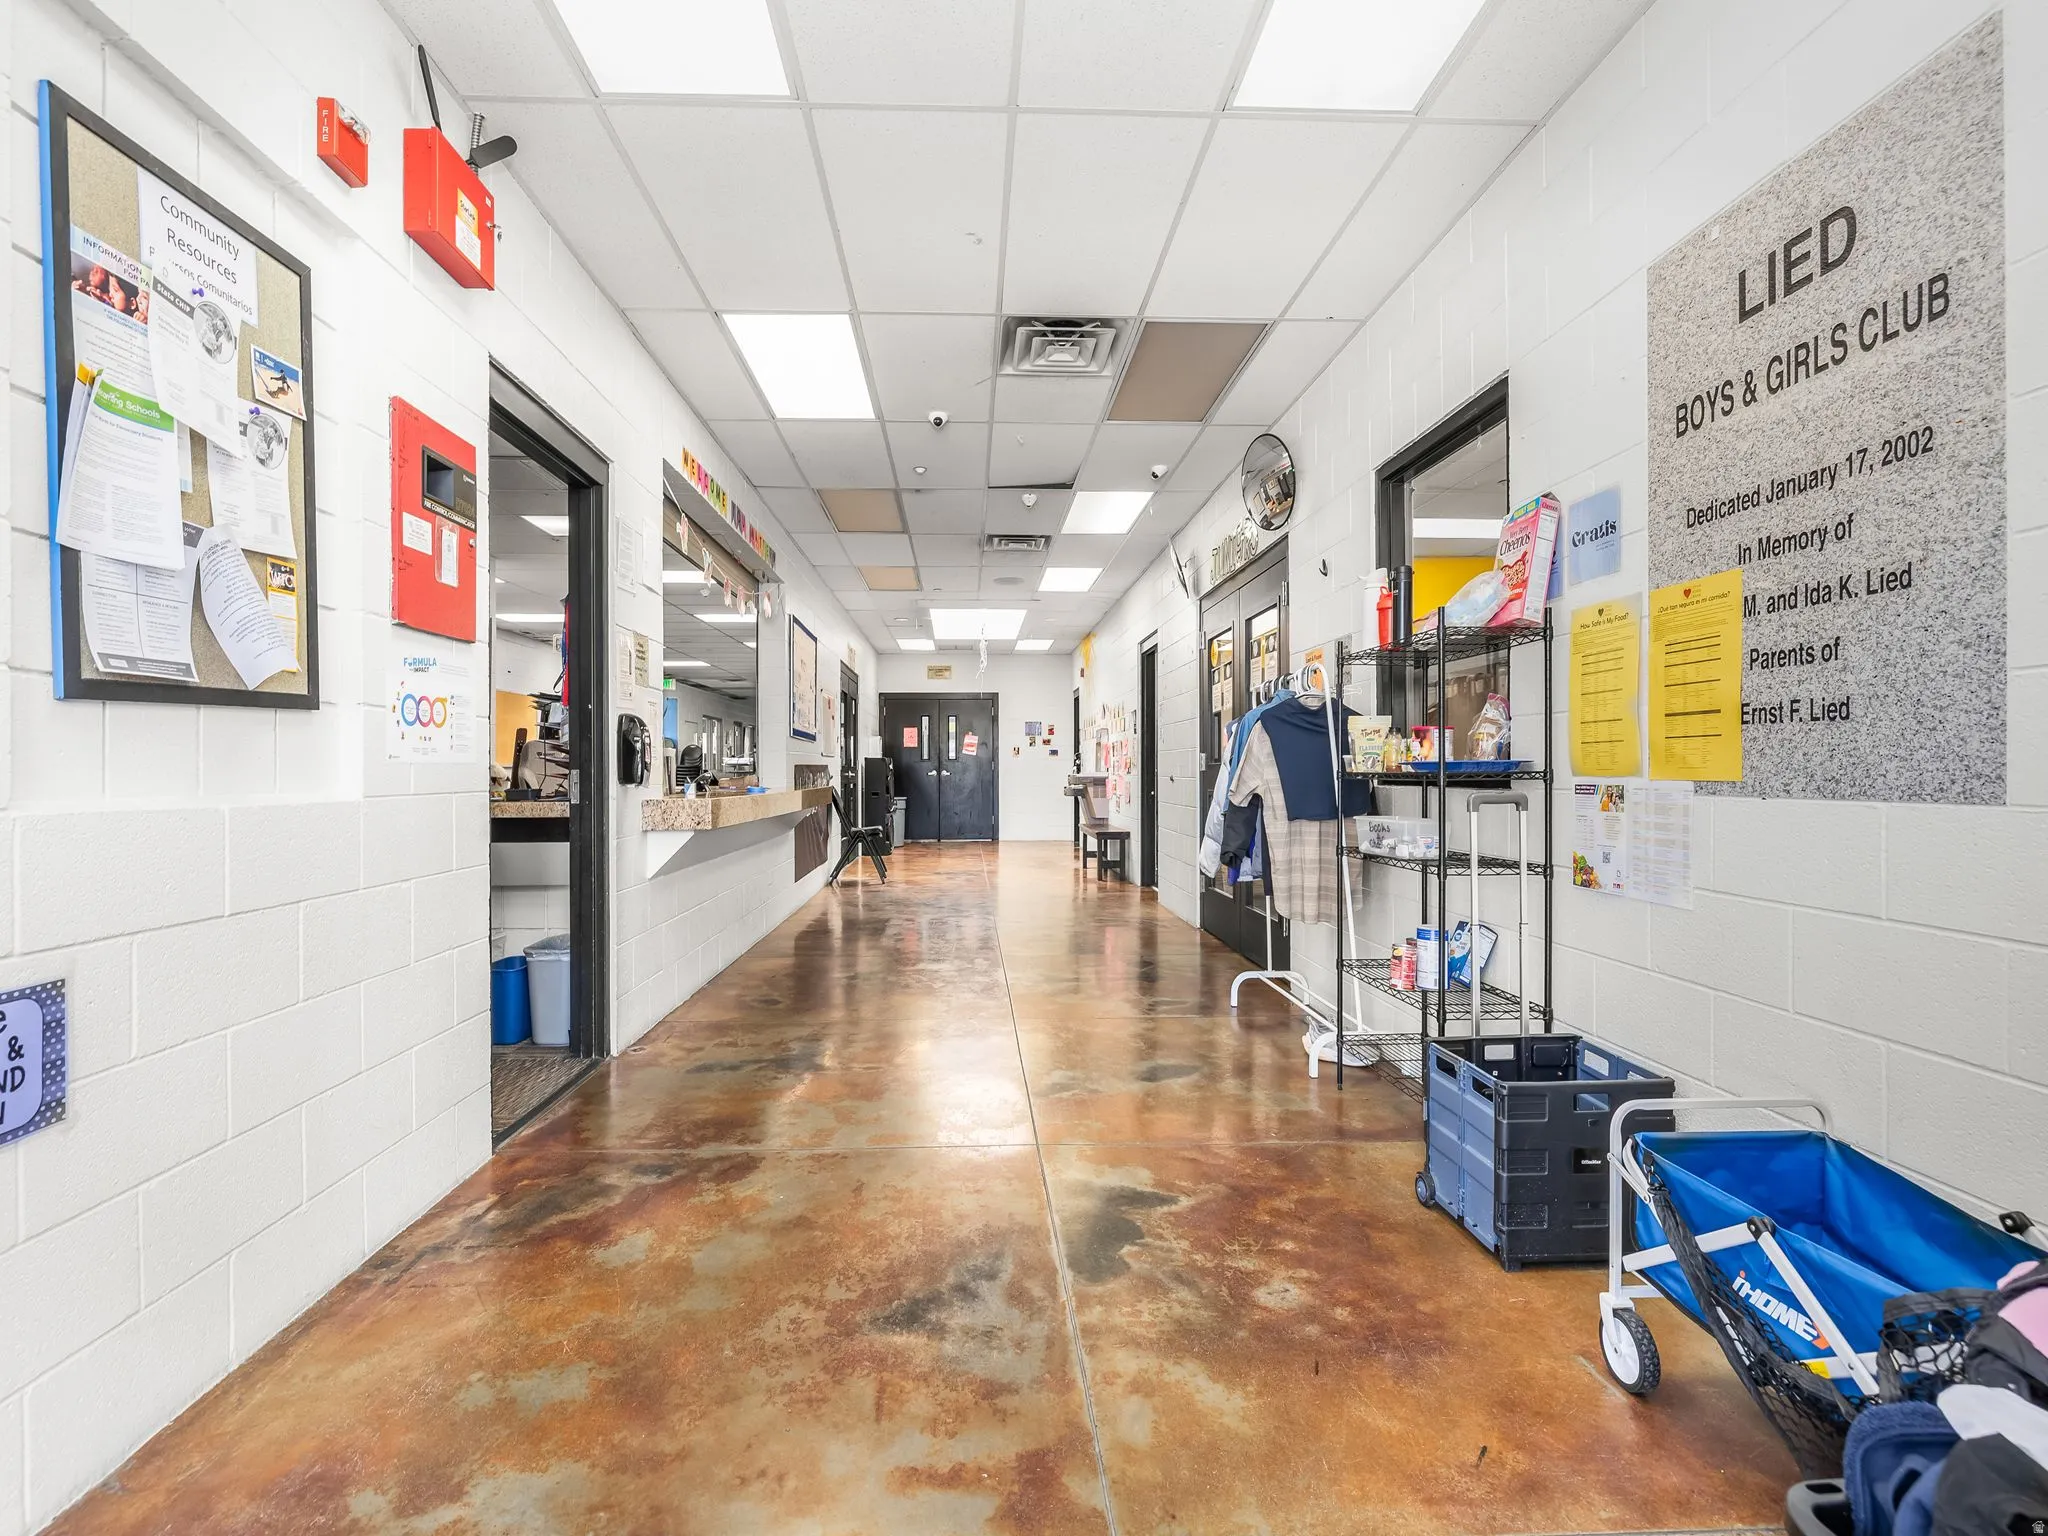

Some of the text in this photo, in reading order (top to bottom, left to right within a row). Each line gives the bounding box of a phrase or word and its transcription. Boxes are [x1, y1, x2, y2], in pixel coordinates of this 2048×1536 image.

[160, 195, 240, 260] Community
[83, 236, 143, 275] INFORMATION
[166, 228, 237, 284] Resources
[1738, 206, 1857, 324] LIED
[197, 274, 253, 316] Comunitarios
[1675, 272, 1951, 438] BOYS & GIRLS CLUB
[126, 400, 161, 419] Schools
[1686, 426, 1934, 529] Dedicated January 17, 2002
[1572, 520, 1617, 547] Gratis
[1738, 513, 1854, 565] In Memory of
[1767, 586, 1798, 615] and
[1804, 580, 1832, 607] Ida
[1839, 574, 1859, 601] K.
[1866, 562, 1913, 596] Lied
[1749, 637, 1840, 671] Parents of
[1741, 696, 1851, 725] Ernst F. Lied
[8, 1035, 25, 1061] &
